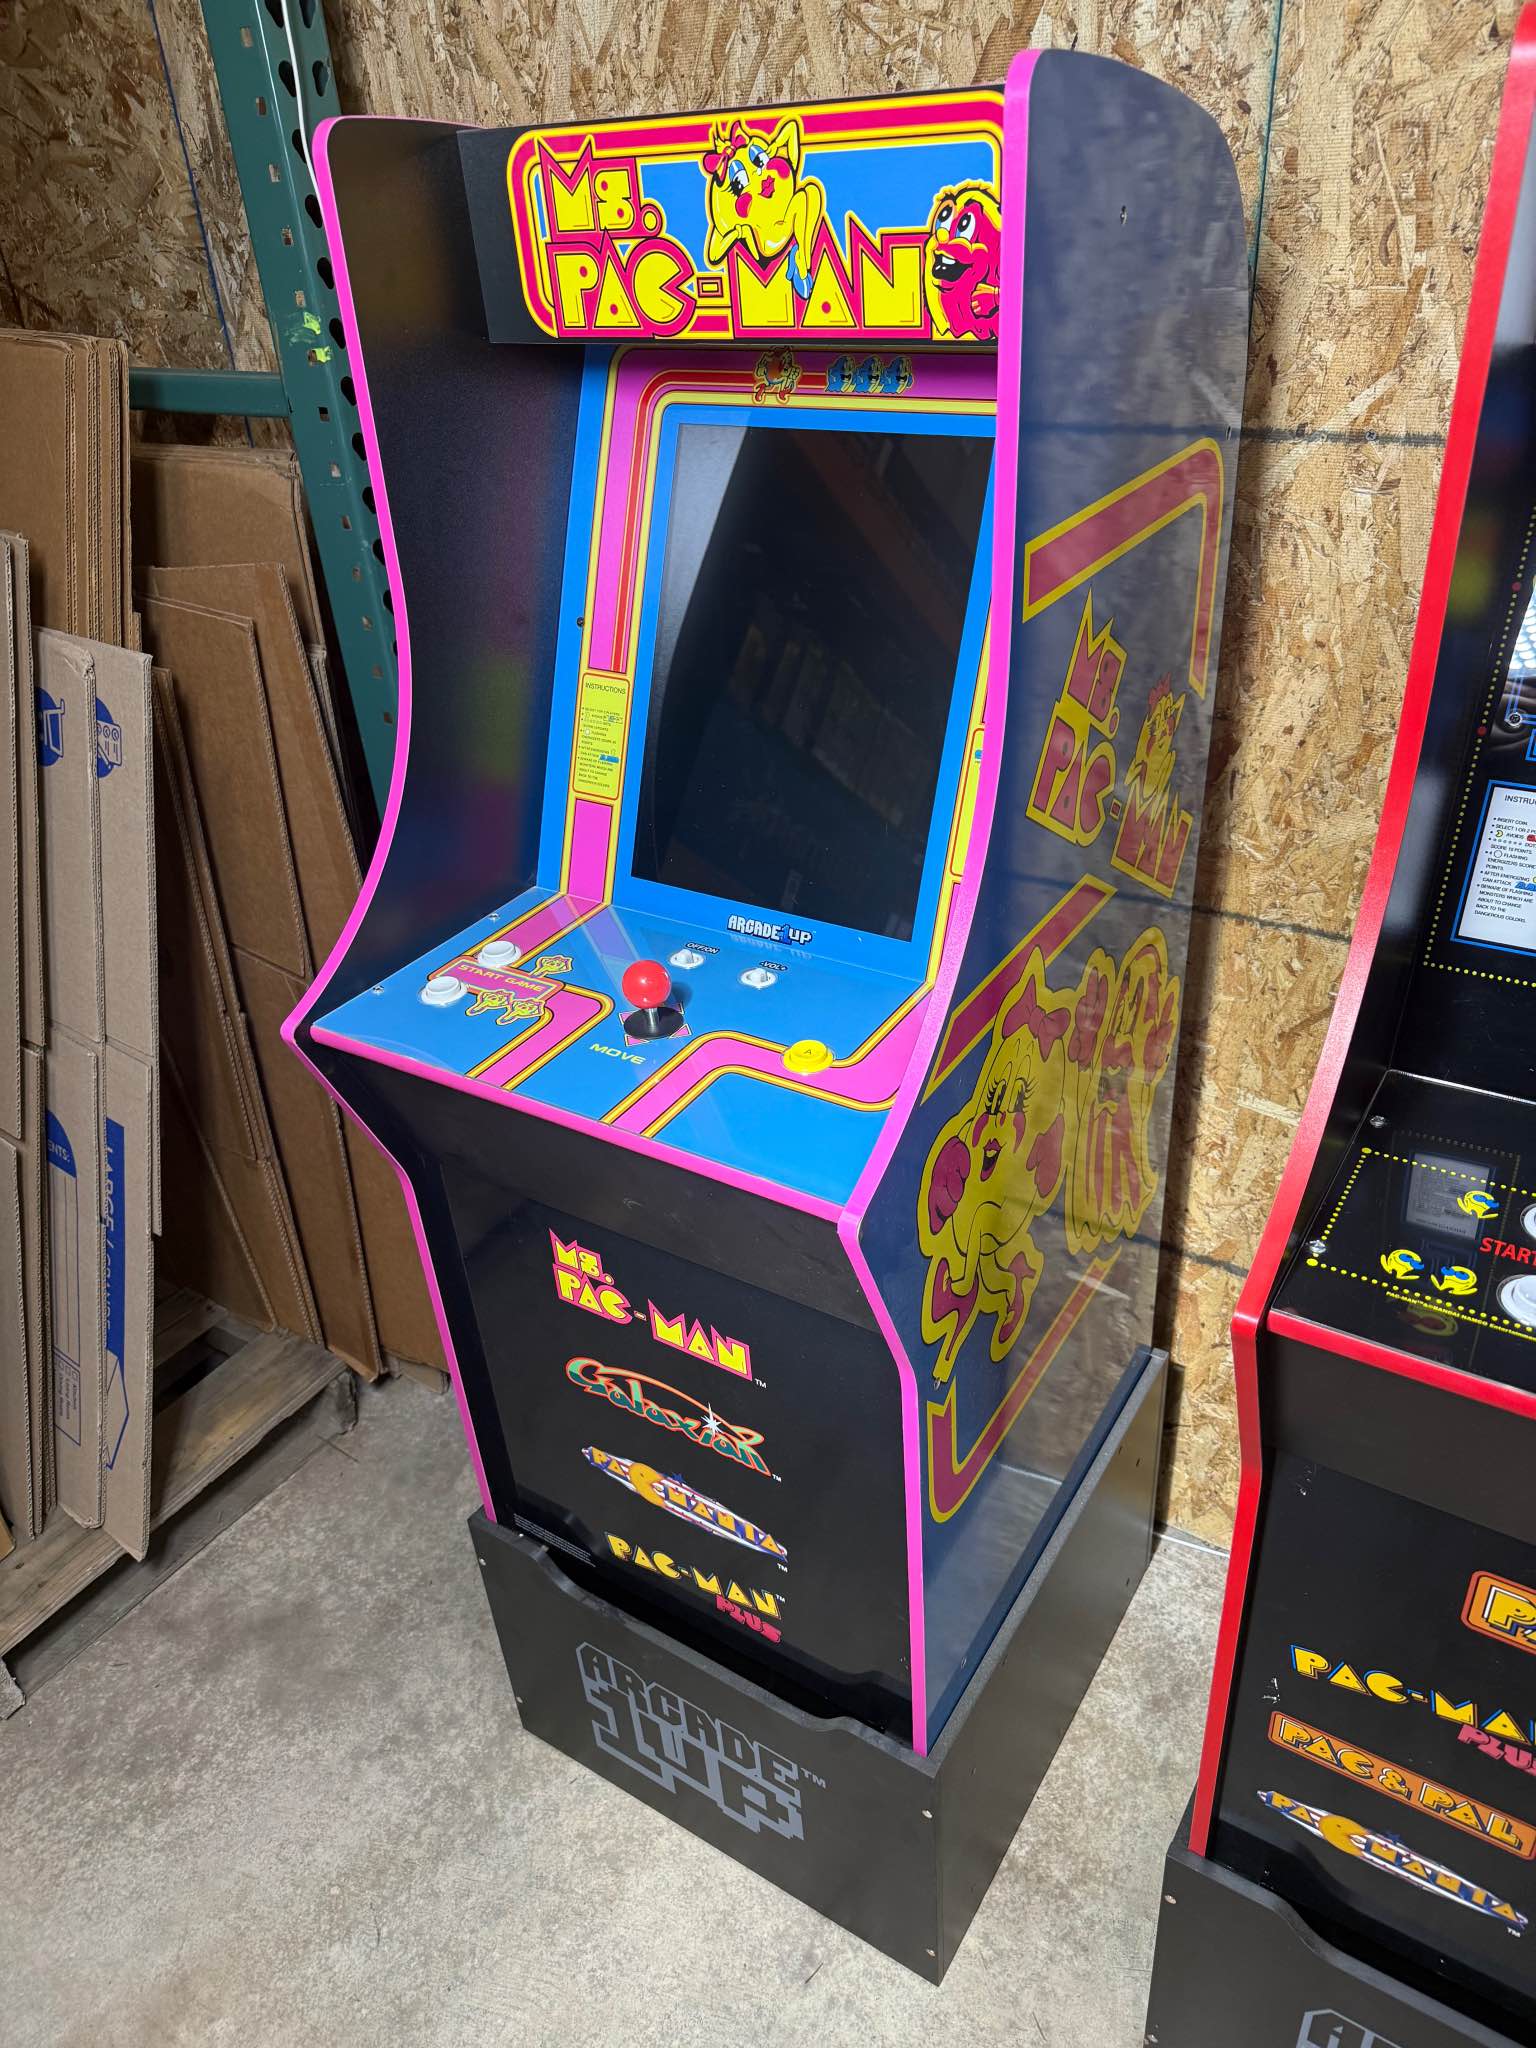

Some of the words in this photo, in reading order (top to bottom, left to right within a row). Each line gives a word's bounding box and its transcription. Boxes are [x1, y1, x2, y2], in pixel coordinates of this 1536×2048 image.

[546, 213, 933, 338] PAC-MAN
[585, 682, 626, 694] INSTRUCTIONS
[1026, 700, 1194, 899] PAC-MAN
[458, 964, 502, 980] START
[505, 978, 546, 992] GAME
[687, 943, 718, 954] OFF/ON
[590, 1043, 647, 1065] MOVE
[552, 1263, 753, 1381] PAC-MAN
[1461, 1314, 1488, 1326] NAMCO
[604, 1531, 782, 1620] PAC-MAN
[715, 1594, 782, 1644] PLUS
[576, 1642, 801, 1808] ARCADE
[1290, 1643, 1536, 1747] PAC-MA
[1279, 1717, 1374, 1780] PAC
[1378, 1767, 1411, 1799] &
[1419, 1782, 1523, 1852] PAL
[1457, 1724, 1536, 1776] PLU
